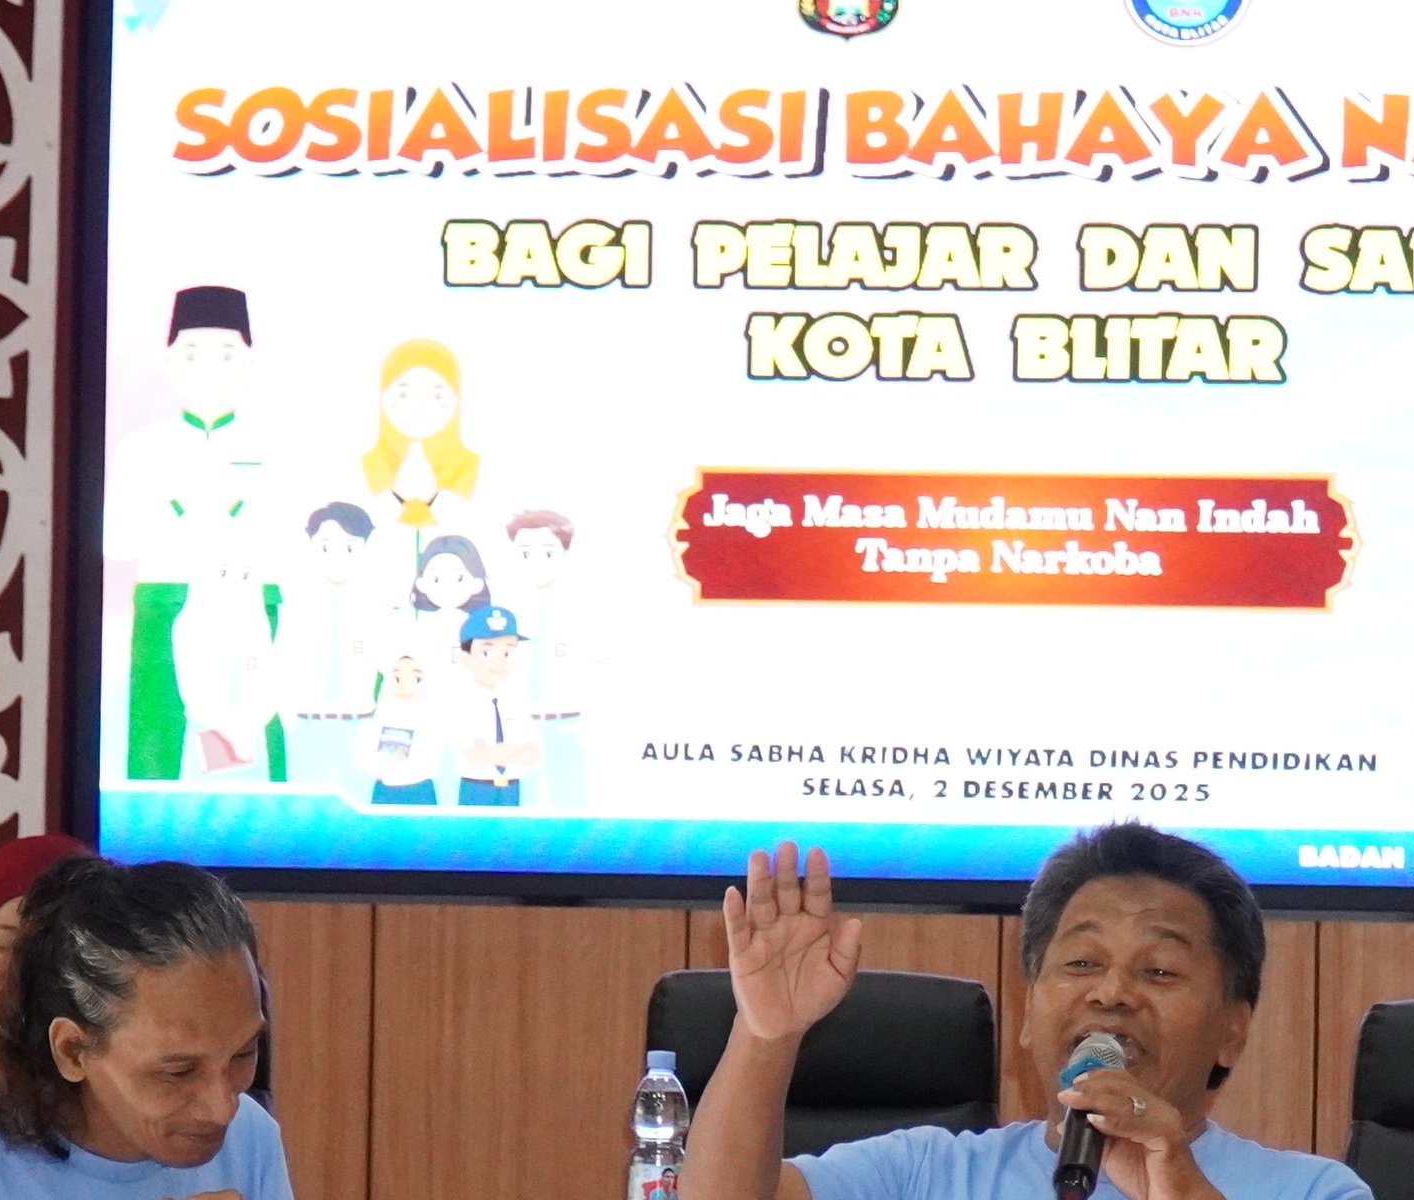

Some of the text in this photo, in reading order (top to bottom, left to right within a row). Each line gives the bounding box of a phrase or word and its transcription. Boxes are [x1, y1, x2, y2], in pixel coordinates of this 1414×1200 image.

[173, 83, 829, 179] SOSIALISASI
[845, 84, 1331, 182] BAHAYA
[442, 219, 653, 289] BAGI
[692, 220, 1038, 291] PELAJAR
[1078, 223, 1258, 293] DAN
[746, 312, 1287, 386] KOTA BLITAR
[703, 494, 1321, 538] Jaga Masa Mudamu Nan Indah
[854, 537, 1163, 583] Tanpa Narkoba
[642, 742, 1378, 772] AULA SABHA KRIDHA WIYATA DINAS PENDIDIKAN
[802, 778, 1212, 802] SELASA, 2 DESEMBER 2025
[1298, 844, 1405, 870] BADAN
